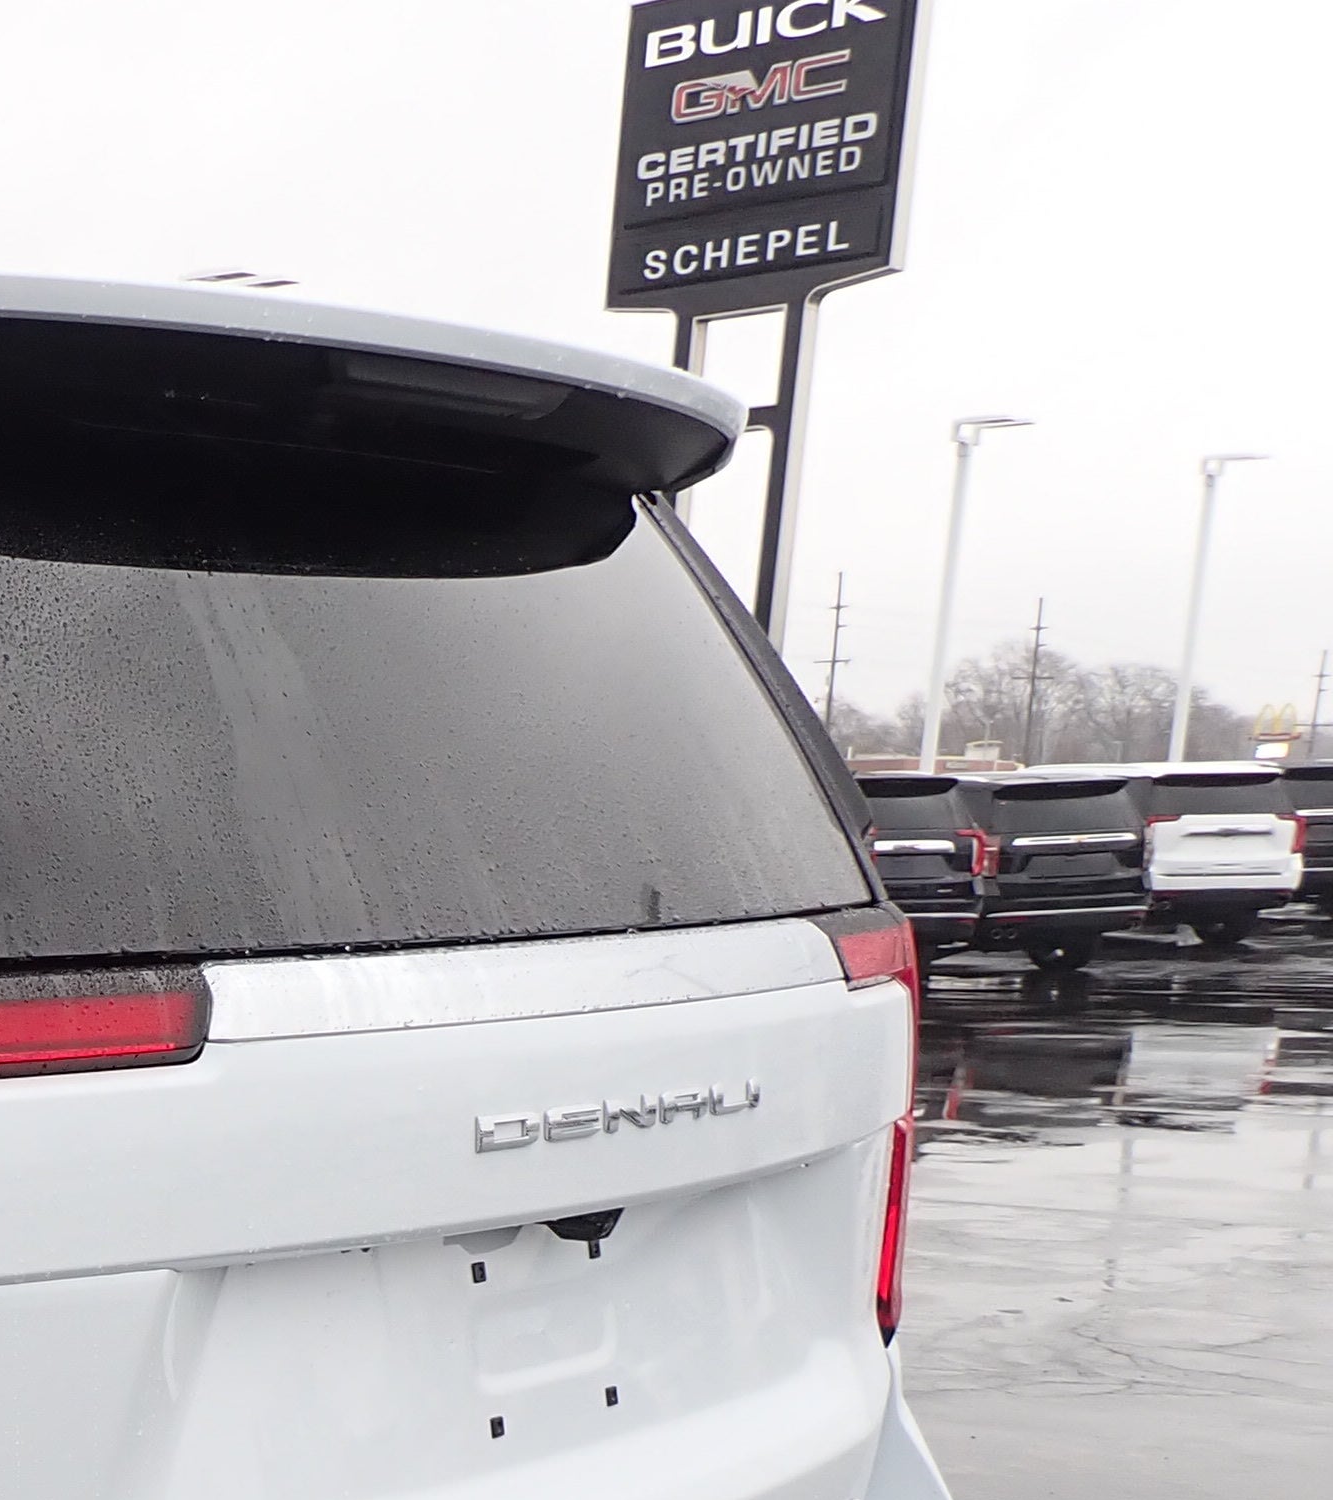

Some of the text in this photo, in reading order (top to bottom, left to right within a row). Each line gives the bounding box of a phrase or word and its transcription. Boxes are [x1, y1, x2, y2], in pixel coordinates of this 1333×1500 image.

[644, 0, 887, 68] BUICK
[671, 49, 851, 124] GMC
[637, 112, 879, 181] CERTIFIED
[645, 146, 862, 207] PRE-OWNED
[643, 221, 850, 281] SCHEPEL
[474, 1076, 762, 1154] DENALI
